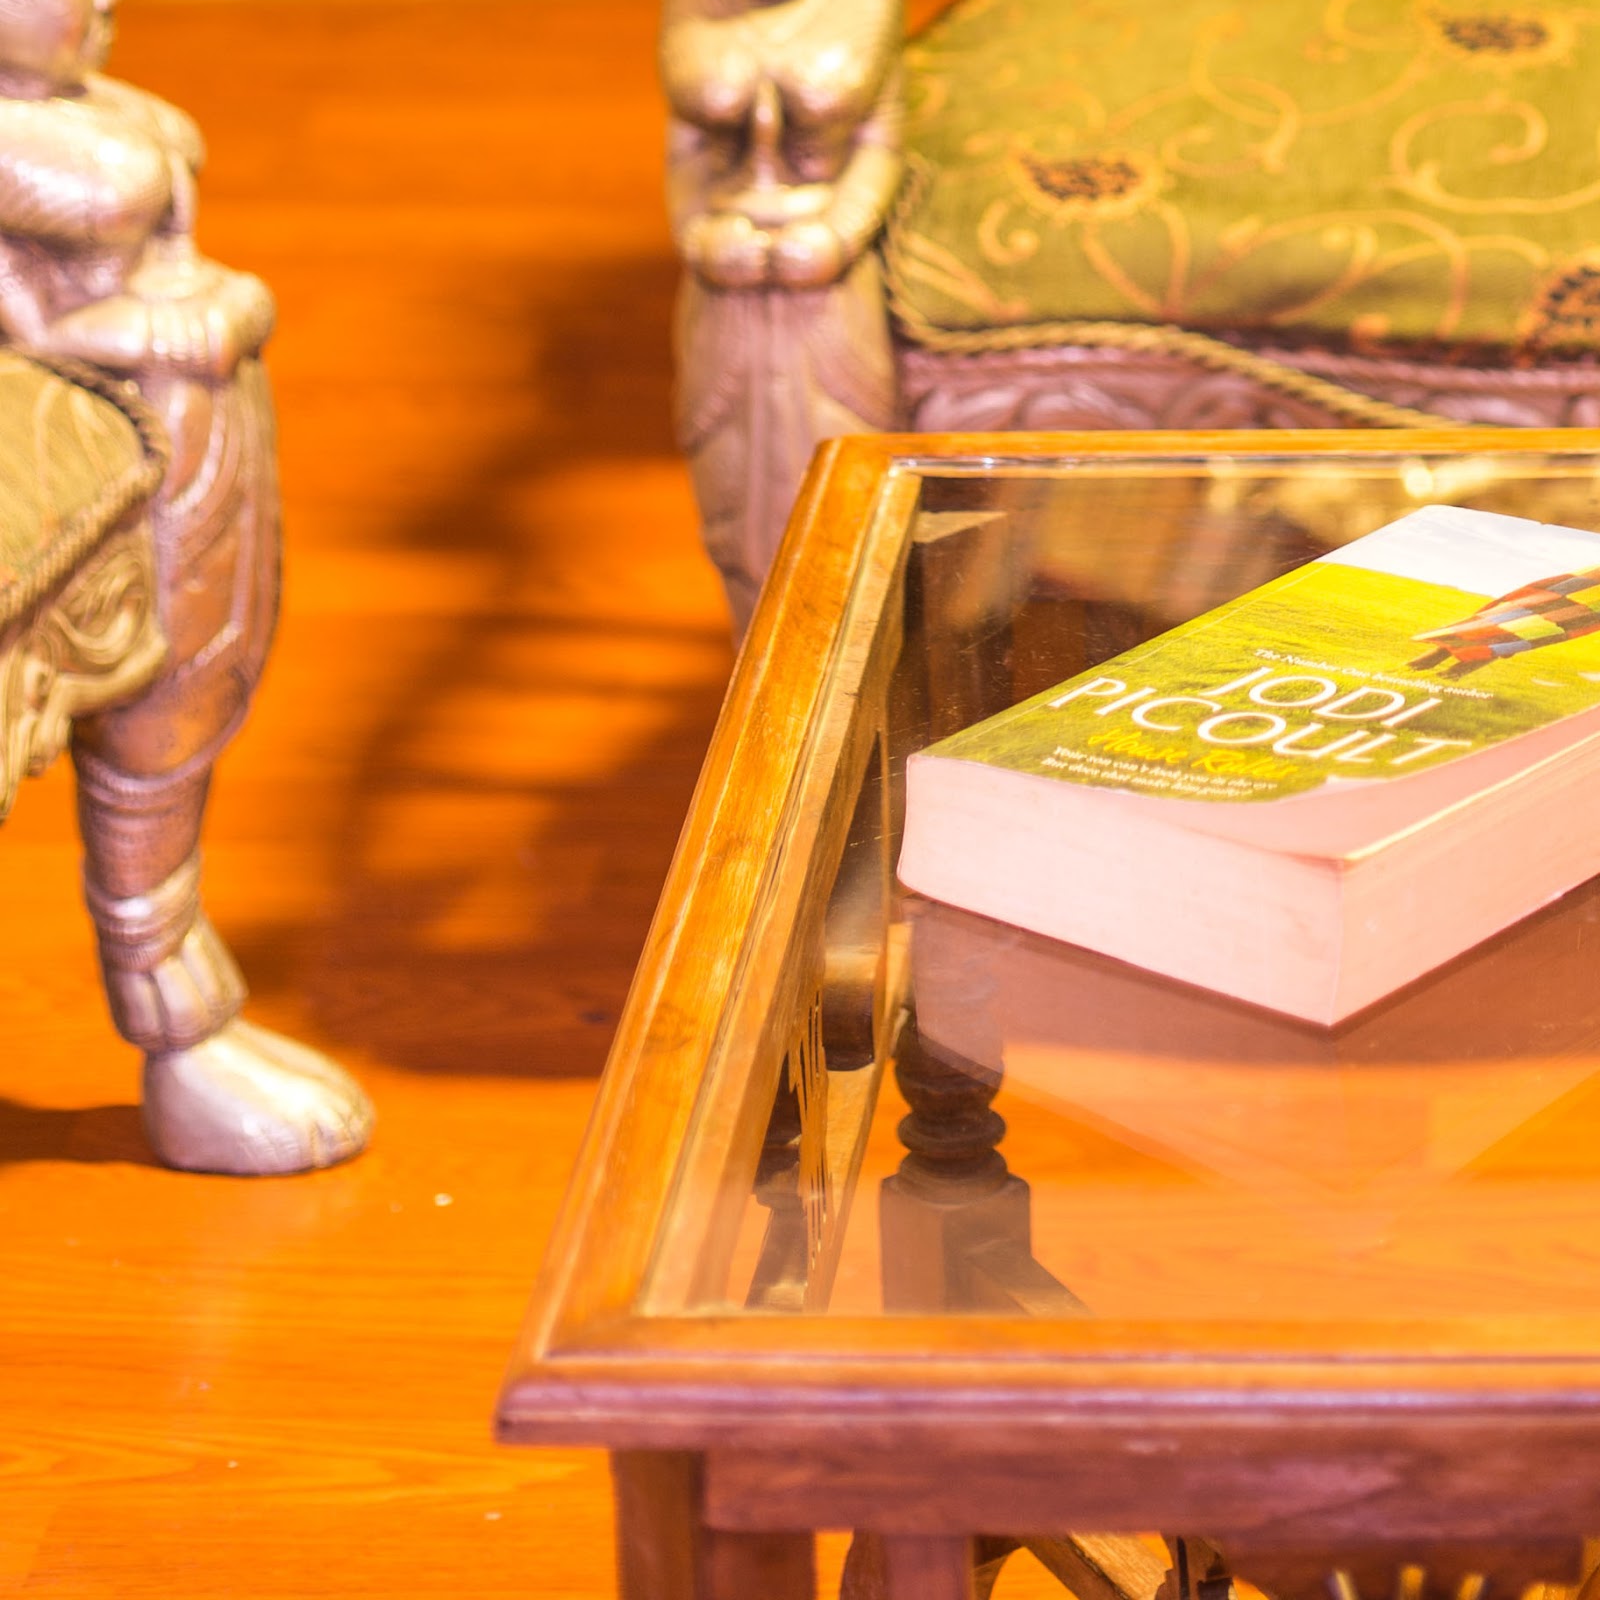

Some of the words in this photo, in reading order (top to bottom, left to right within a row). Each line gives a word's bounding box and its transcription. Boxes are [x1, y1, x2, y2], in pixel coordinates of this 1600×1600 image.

[1200, 666, 1443, 727] JODI
[1254, 648, 1281, 660] The
[1280, 655, 1339, 672] Number
[1341, 667, 1371, 678] One
[1443, 686, 1494, 699] author
[1047, 677, 1473, 766] PICOULT
[1087, 728, 1189, 764] House
[1190, 749, 1299, 780] Rules
